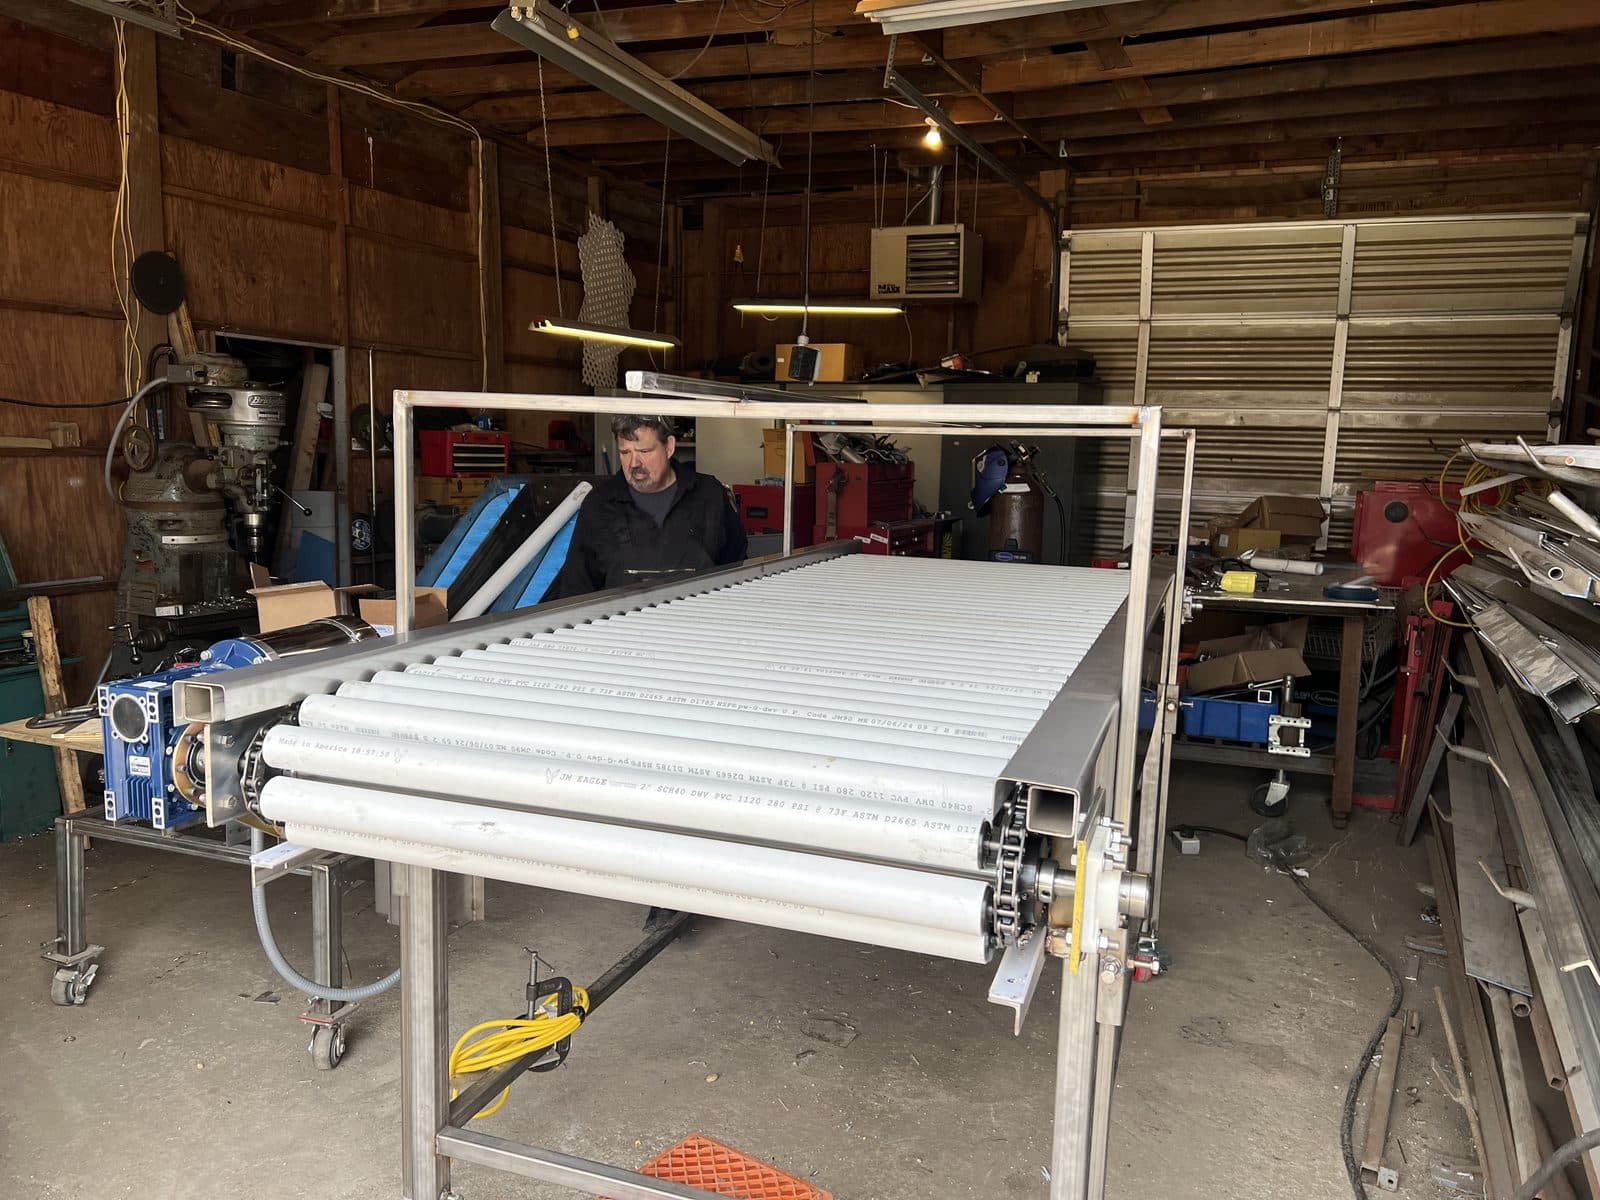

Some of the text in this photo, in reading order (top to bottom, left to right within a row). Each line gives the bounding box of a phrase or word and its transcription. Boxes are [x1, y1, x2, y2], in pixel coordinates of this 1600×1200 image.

[806, 711, 828, 719] Code
[655, 764, 684, 774] D1785
[687, 767, 711, 777] ASTM
[716, 770, 745, 781] D2665
[749, 775, 773, 785] ASTM
[836, 787, 854, 796] 280
[860, 791, 885, 800] 1120
[559, 773, 573, 781] JM
[576, 776, 608, 786] EAGLE
[656, 785, 686, 795] SCH40
[690, 790, 709, 799] DWV
[714, 793, 732, 801] PVC
[738, 795, 761, 804] 1120
[767, 799, 785, 808] 280
[791, 803, 809, 811] PSI
[828, 808, 848, 816] 73F
[852, 811, 880, 821] ASTM
[884, 815, 918, 826] D2665
[923, 821, 951, 831] ASTM
[890, 795, 909, 803] PVC
[915, 798, 935, 807] DWV
[941, 801, 973, 812] SCH40
